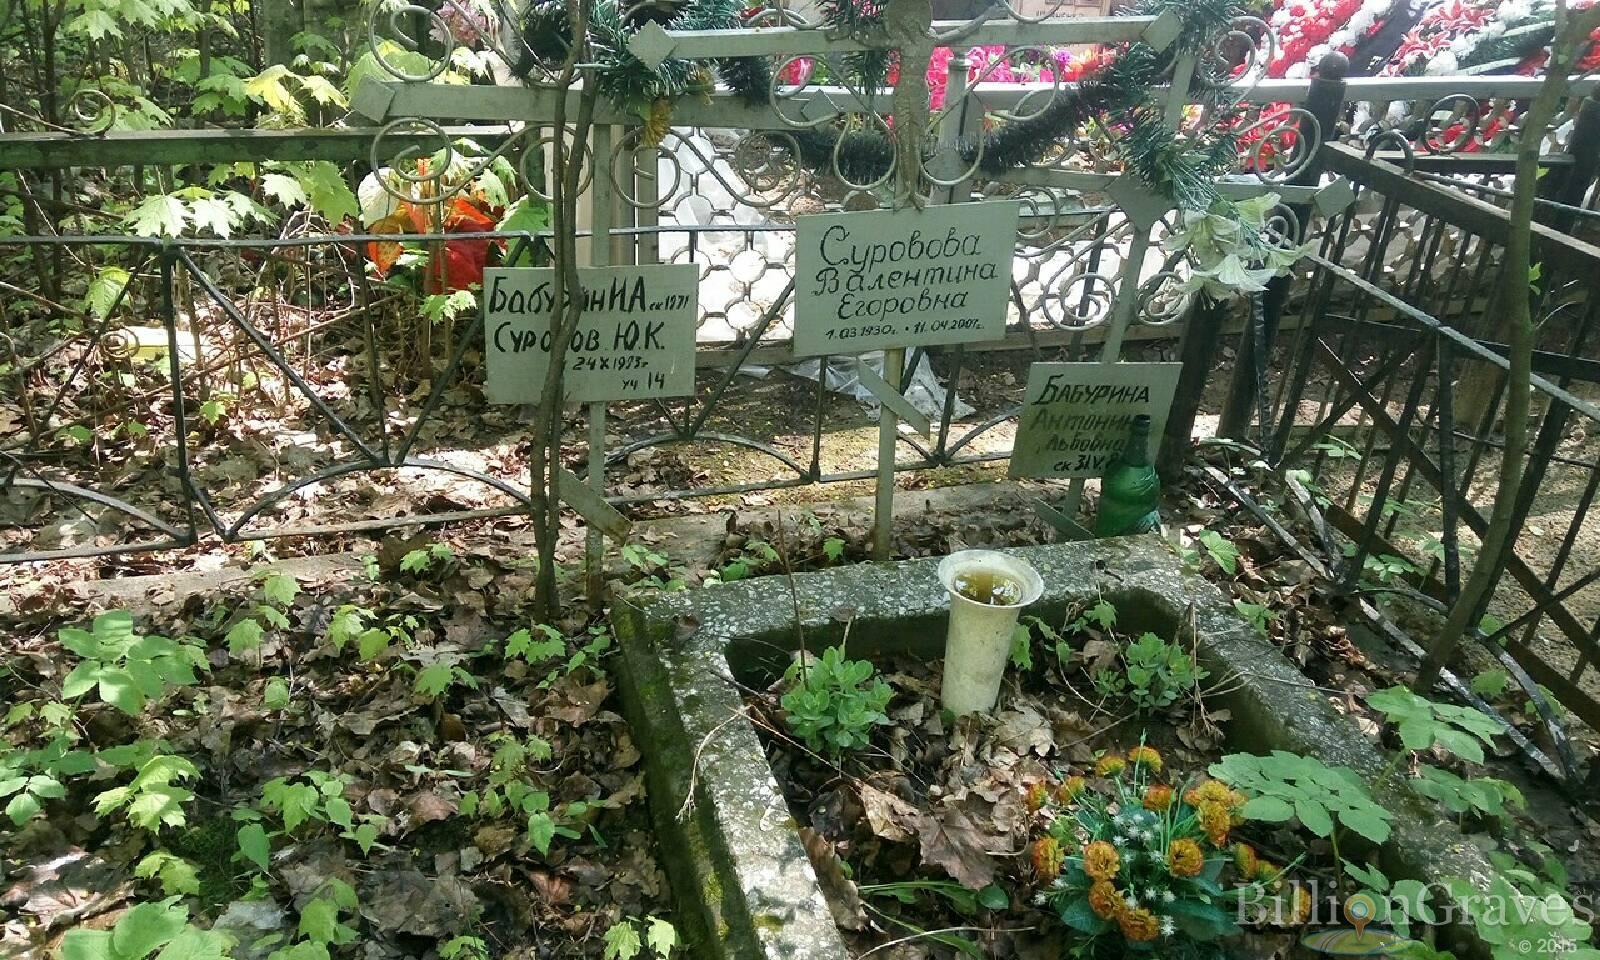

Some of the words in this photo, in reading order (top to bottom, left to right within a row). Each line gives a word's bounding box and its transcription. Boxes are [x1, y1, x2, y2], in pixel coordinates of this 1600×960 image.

[820, 225, 981, 272] Суровова
[811, 263, 998, 296] Валентина
[838, 288, 969, 321] Егоровна
[494, 321, 600, 353] Суроов
[1029, 408, 1134, 431] Антонин
